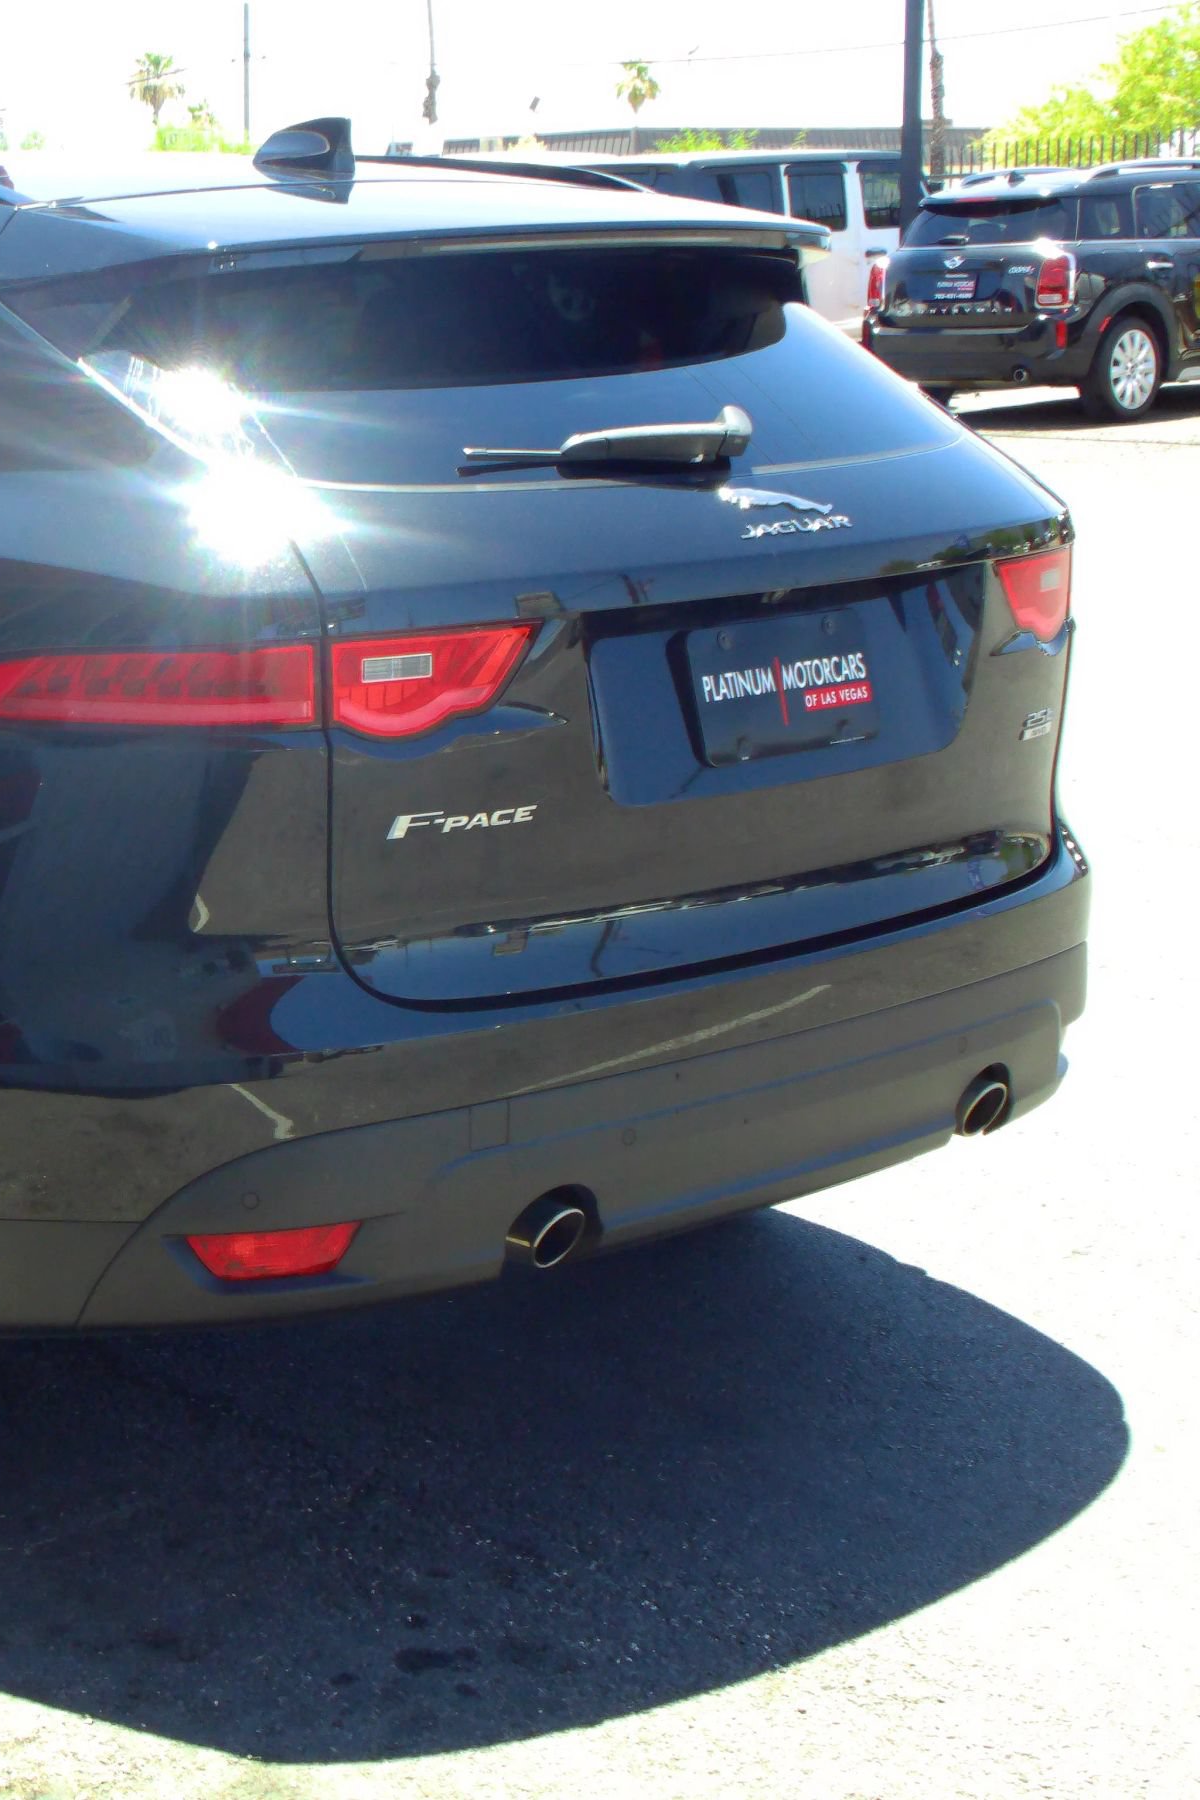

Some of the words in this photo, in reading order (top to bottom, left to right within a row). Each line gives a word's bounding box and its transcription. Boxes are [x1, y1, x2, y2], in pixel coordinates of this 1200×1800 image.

[739, 515, 852, 540] JAGUAR
[702, 667, 776, 702] PLATINUM
[781, 652, 867, 690] MOTORCARS
[805, 694, 818, 707] OF
[820, 691, 838, 706] LAS
[839, 686, 869, 703] VEGAS
[386, 805, 538, 840] F-PACE
